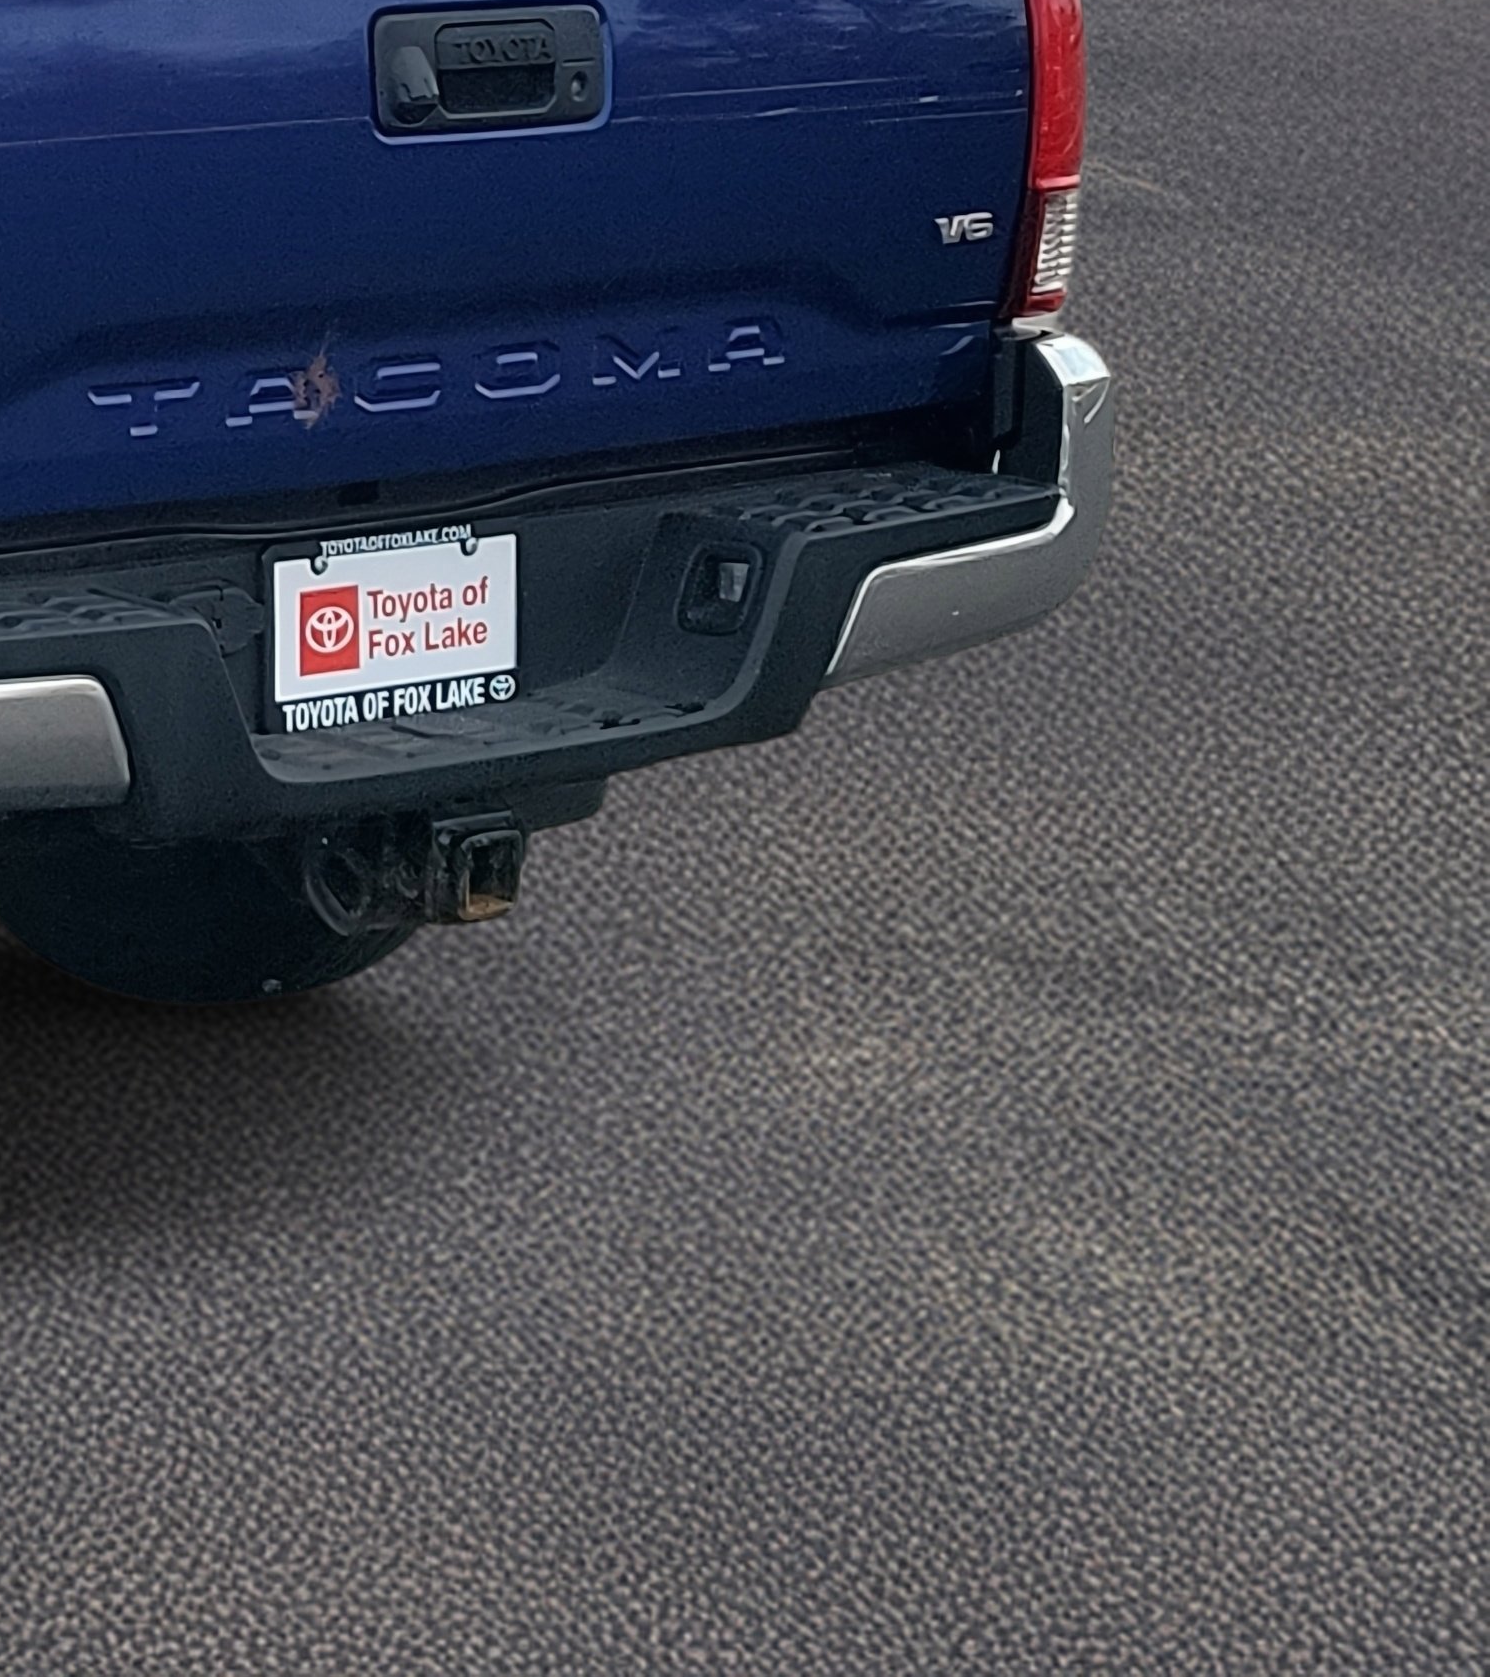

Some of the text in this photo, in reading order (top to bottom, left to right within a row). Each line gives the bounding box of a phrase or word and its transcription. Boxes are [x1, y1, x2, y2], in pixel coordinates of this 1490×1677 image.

[453, 35, 554, 64] TOYOTA
[933, 211, 994, 245] V6
[86, 316, 787, 438] TACOMA
[320, 524, 472, 557] TOYOTAOFFOXLAKE.COM
[366, 575, 489, 623] Toyota of
[368, 617, 488, 660] Fox Lake
[282, 676, 486, 733] TOYOTA OF FOX LAKE
